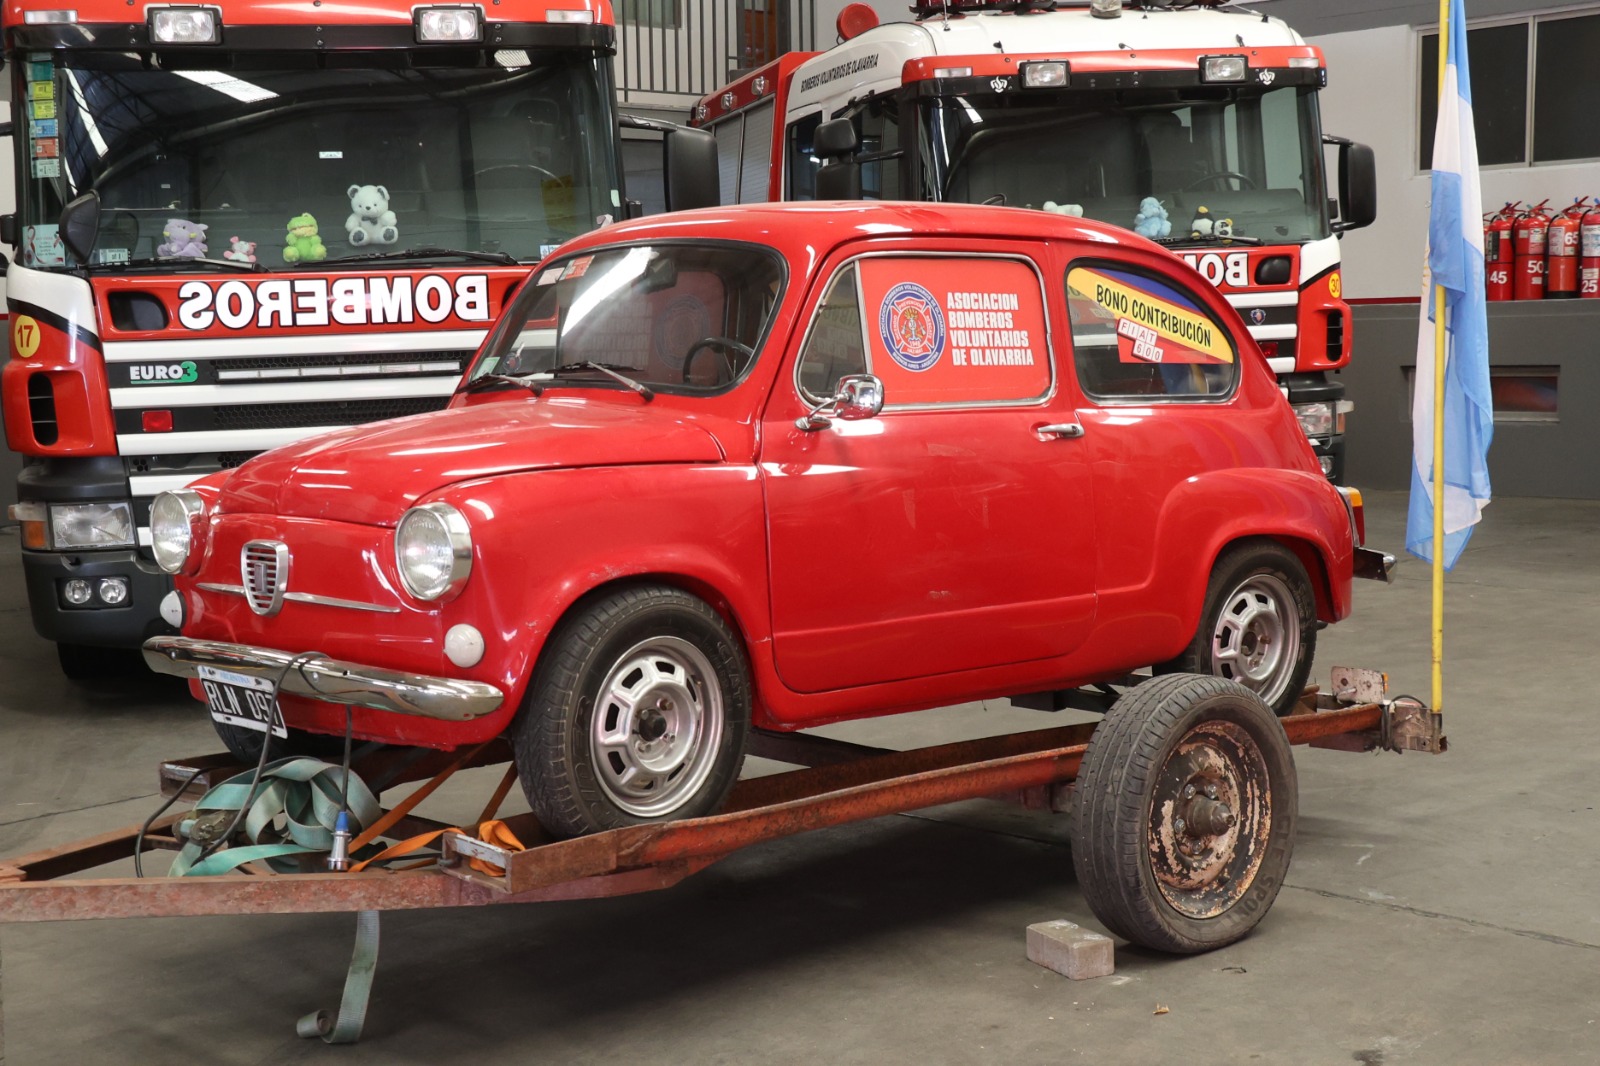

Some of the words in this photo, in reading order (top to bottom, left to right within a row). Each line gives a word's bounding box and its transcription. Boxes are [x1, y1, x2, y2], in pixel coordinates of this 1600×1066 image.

[1564, 232, 1579, 245] 65
[1527, 260, 1544, 274] 50
[1330, 278, 1340, 294] 30
[1490, 271, 1508, 284] 45
[1581, 280, 1598, 293] 25
[947, 292, 1019, 310] ASOCIACION
[948, 311, 1014, 329] BOMBEROS
[1096, 284, 1128, 314] BONO
[1131, 299, 1211, 347] CONTRIBUCIÓN
[17, 324, 34, 348] 17
[949, 330, 1029, 347] VOLUNTARIOS
[1120, 322, 1155, 342] FIAT
[952, 348, 968, 366] DE
[970, 348, 1034, 366] OLAVARRIA
[1136, 344, 1161, 361] 600
[202, 680, 243, 716] RLN
